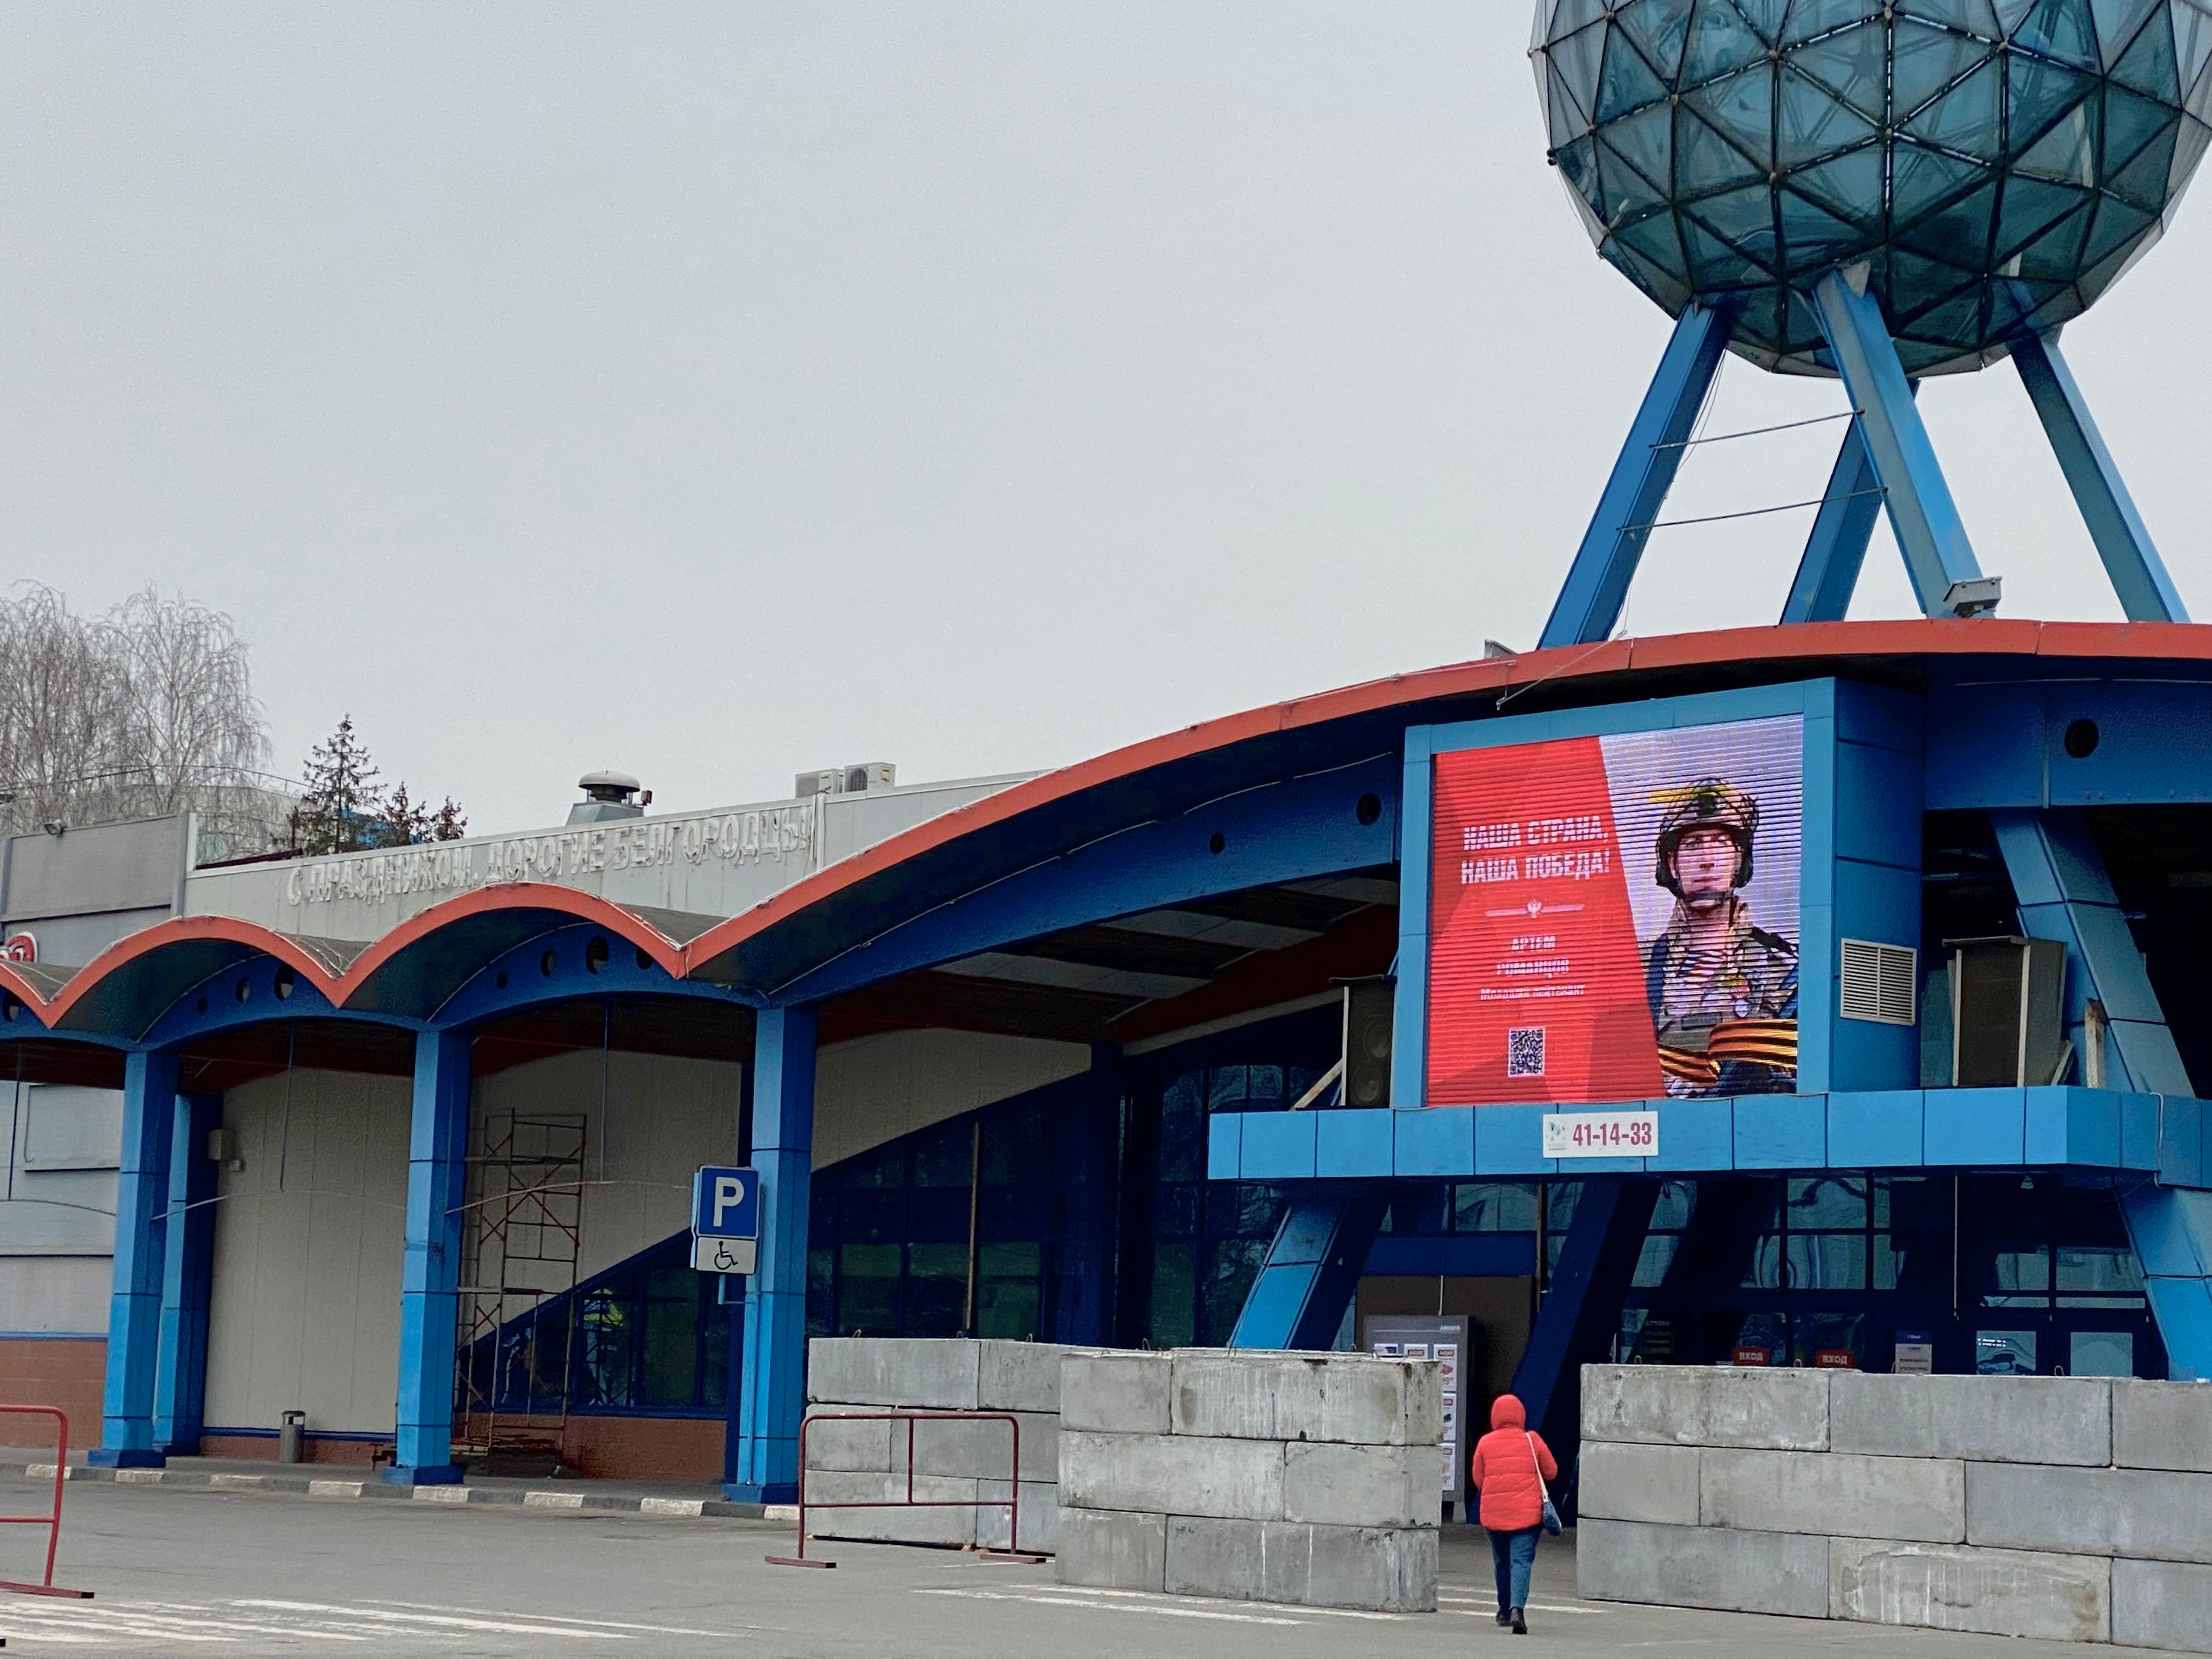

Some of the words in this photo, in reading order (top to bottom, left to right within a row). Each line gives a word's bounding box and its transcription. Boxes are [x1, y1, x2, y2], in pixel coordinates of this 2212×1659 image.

[1463, 823, 1521, 850] НАША
[1528, 816, 1609, 844] СТРАНА,
[287, 866, 302, 906] С
[486, 830, 605, 884] ДОРОГИЕ
[1462, 857, 1519, 884] НАША
[1525, 849, 1610, 881] ПОБЕДА!
[1573, 1122, 1651, 1146] 41-14-33
[713, 1176, 744, 1227] P
[1739, 1352, 1763, 1361] ВХОД
[1822, 1355, 1847, 1365] ВХОД
